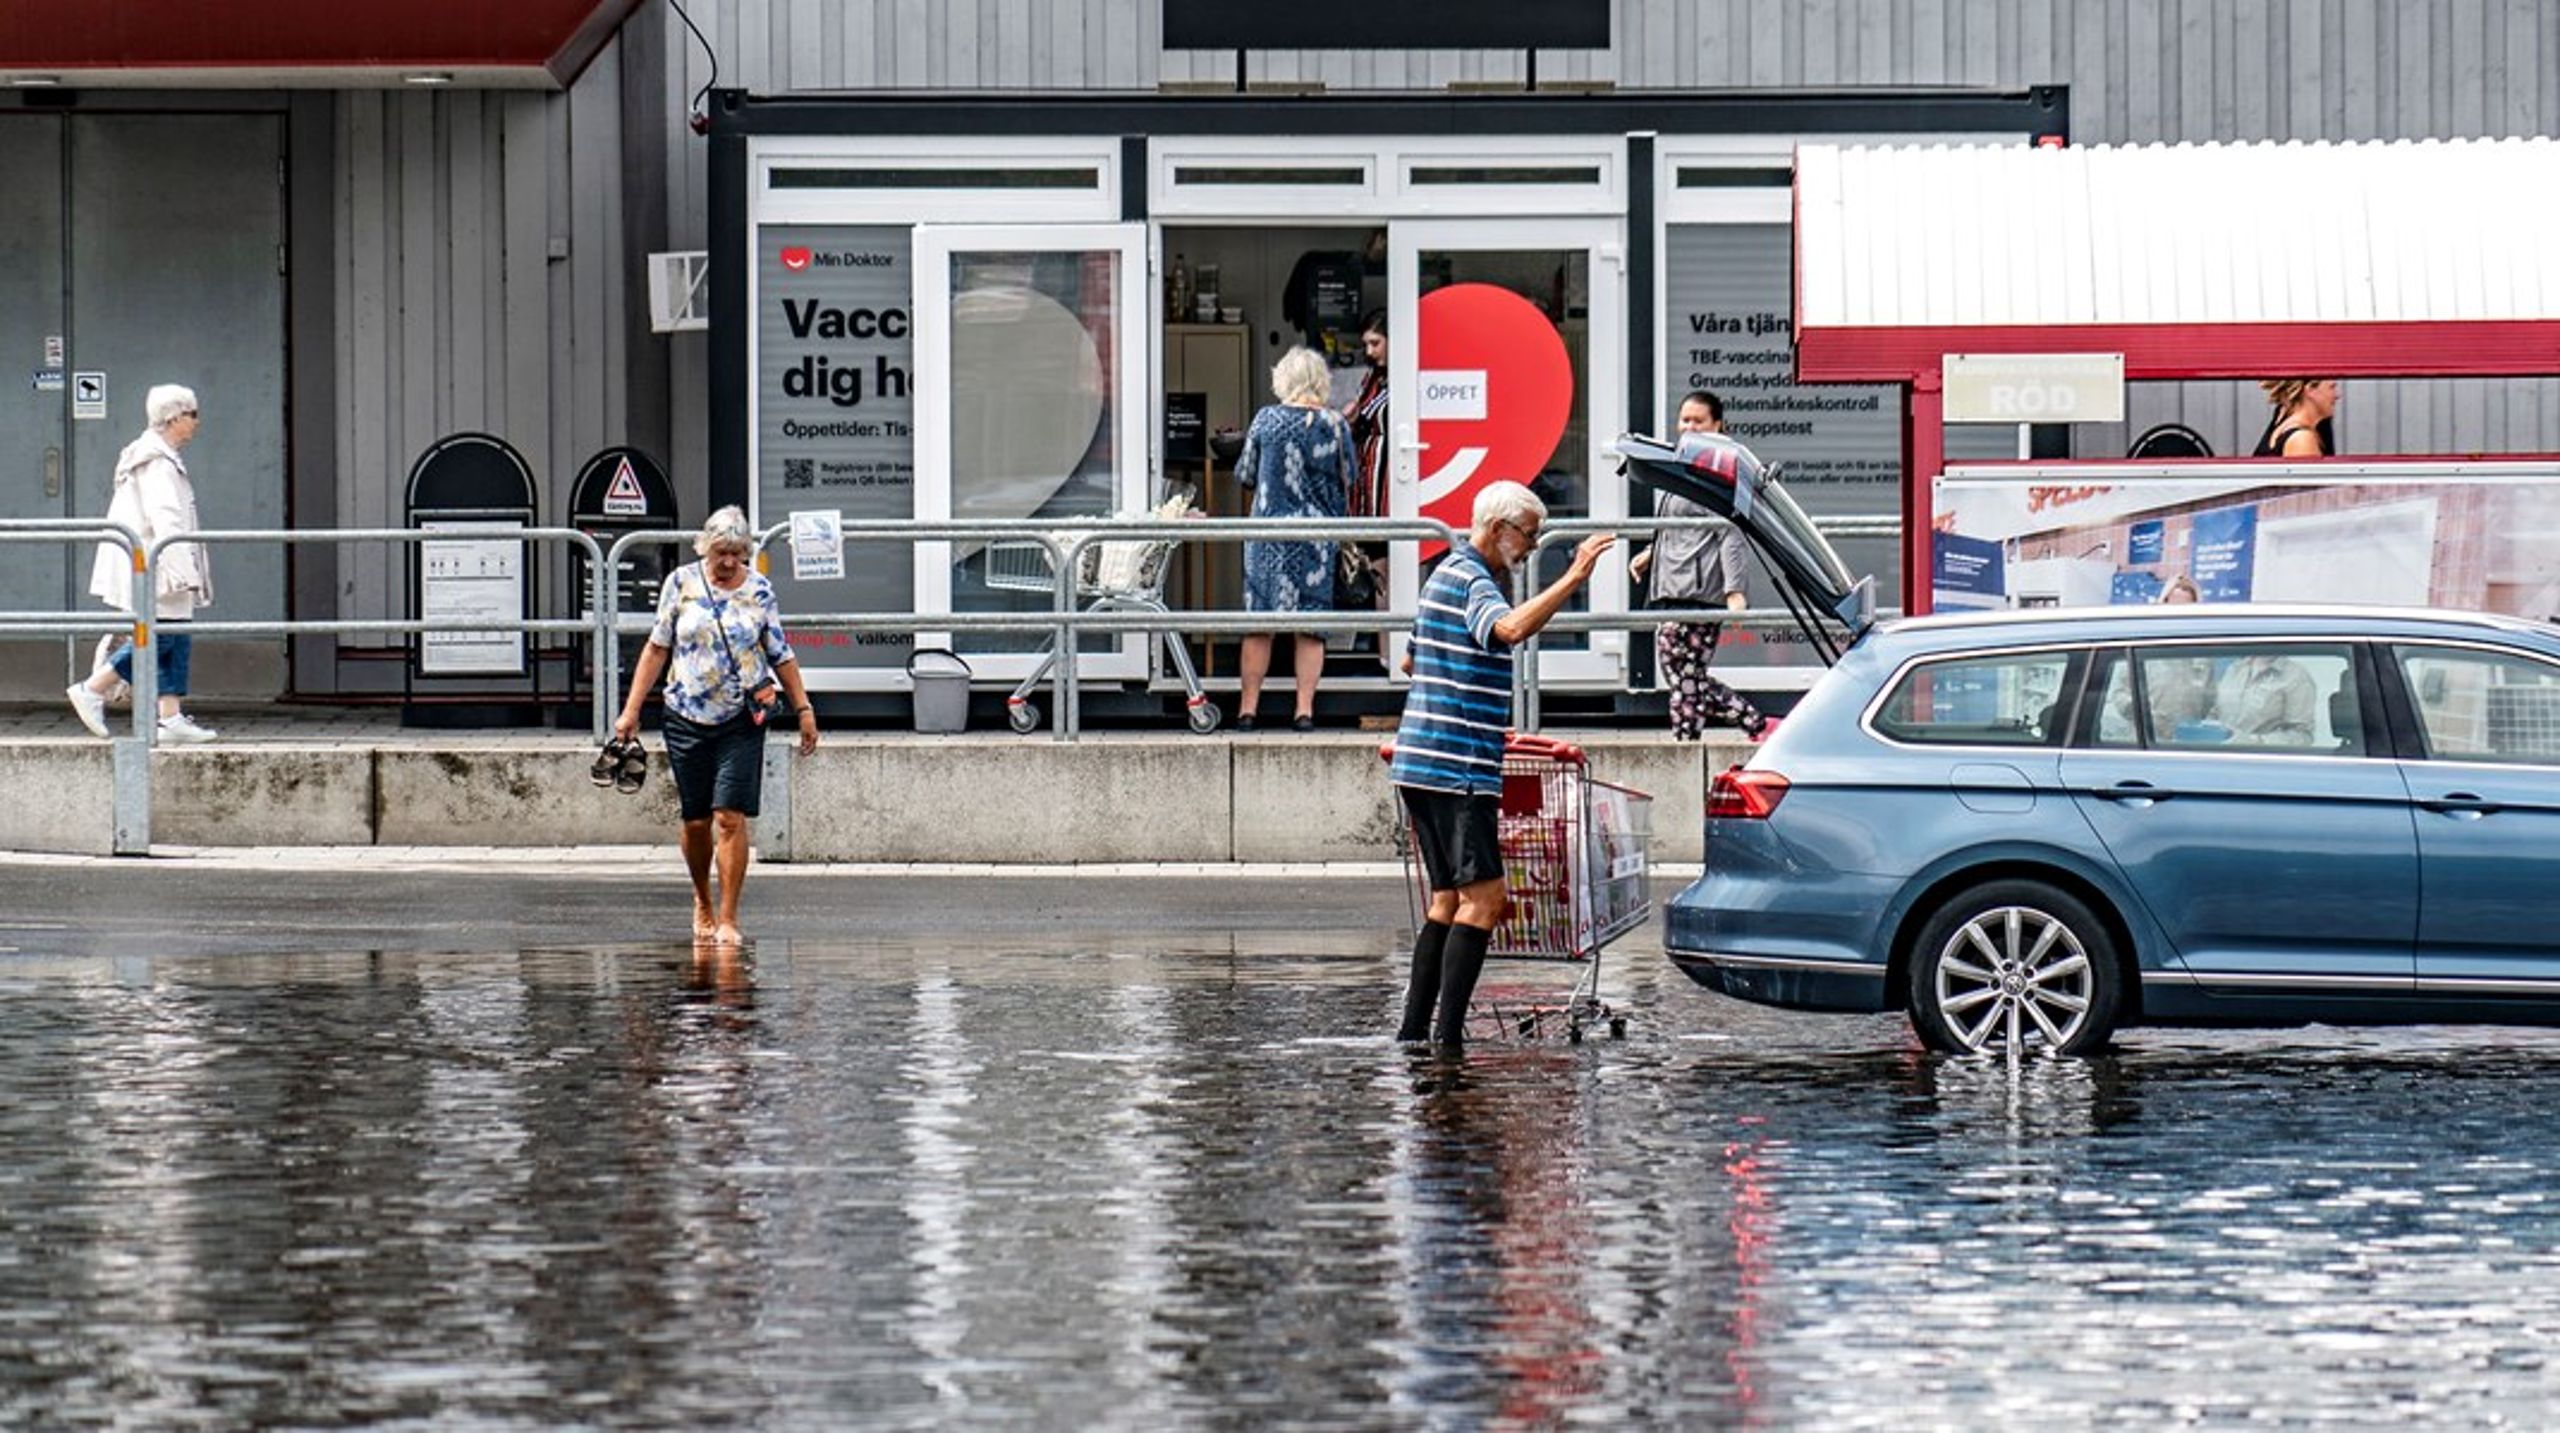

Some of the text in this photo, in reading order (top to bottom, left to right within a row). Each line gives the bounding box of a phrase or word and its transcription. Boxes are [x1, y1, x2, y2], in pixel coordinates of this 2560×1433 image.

[815, 252, 893, 267] Min Doktor
[1689, 314, 1790, 337] Våra tjän
[1689, 350, 1791, 365] TBE-vaccina
[782, 355, 862, 408] dig
[1426, 383, 1477, 400] ÖPPET
[1990, 379, 2076, 414] RÖD
[1722, 396, 1879, 412] elsemärkeskontroll
[782, 418, 880, 439] Öppettider:
[1722, 421, 1813, 437] kroppstest
[1784, 473, 1817, 483] koden
